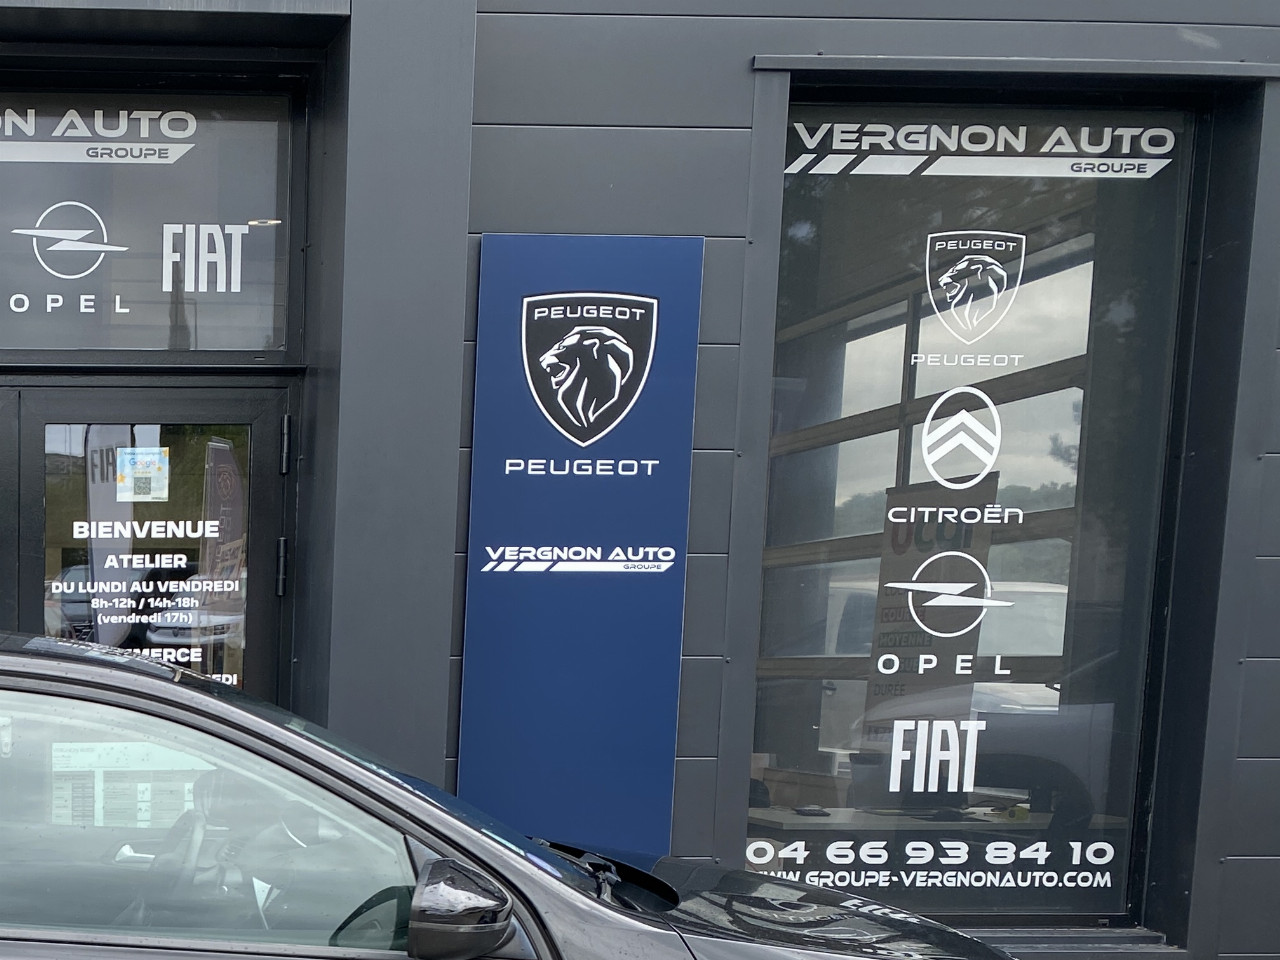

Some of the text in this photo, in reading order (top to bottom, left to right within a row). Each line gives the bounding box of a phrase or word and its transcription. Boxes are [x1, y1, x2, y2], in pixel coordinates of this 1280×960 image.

[51, 108, 198, 139] AUTO
[794, 122, 1176, 154] VERGNON AUTO
[86, 146, 170, 160] GROUPE
[1071, 162, 1147, 174] GROUPE
[935, 239, 1018, 252] PEUGEOT
[162, 223, 248, 293] FIAT
[9, 294, 130, 314] OPEL
[534, 306, 646, 321] PEUGEOT
[910, 353, 1025, 367] PEUGEOT
[129, 457, 157, 468] Google
[505, 459, 660, 476] PEUGEOT
[72, 520, 220, 539] BIENVENUE
[104, 553, 187, 569] ATELIER
[485, 546, 676, 561] VERGNON AUTO
[622, 563, 662, 571] GROUPE
[51, 580, 240, 594] DU LUNDI AU VENDREDI
[90, 598, 137, 609] 8h-12h
[149, 598, 199, 608] 14h-18h
[97, 613, 193, 624] (vendredi 17h)
[877, 653, 1012, 676] OPEL
[888, 719, 987, 793] FIAT
[745, 840, 1115, 865] 04 66 93 84 10
